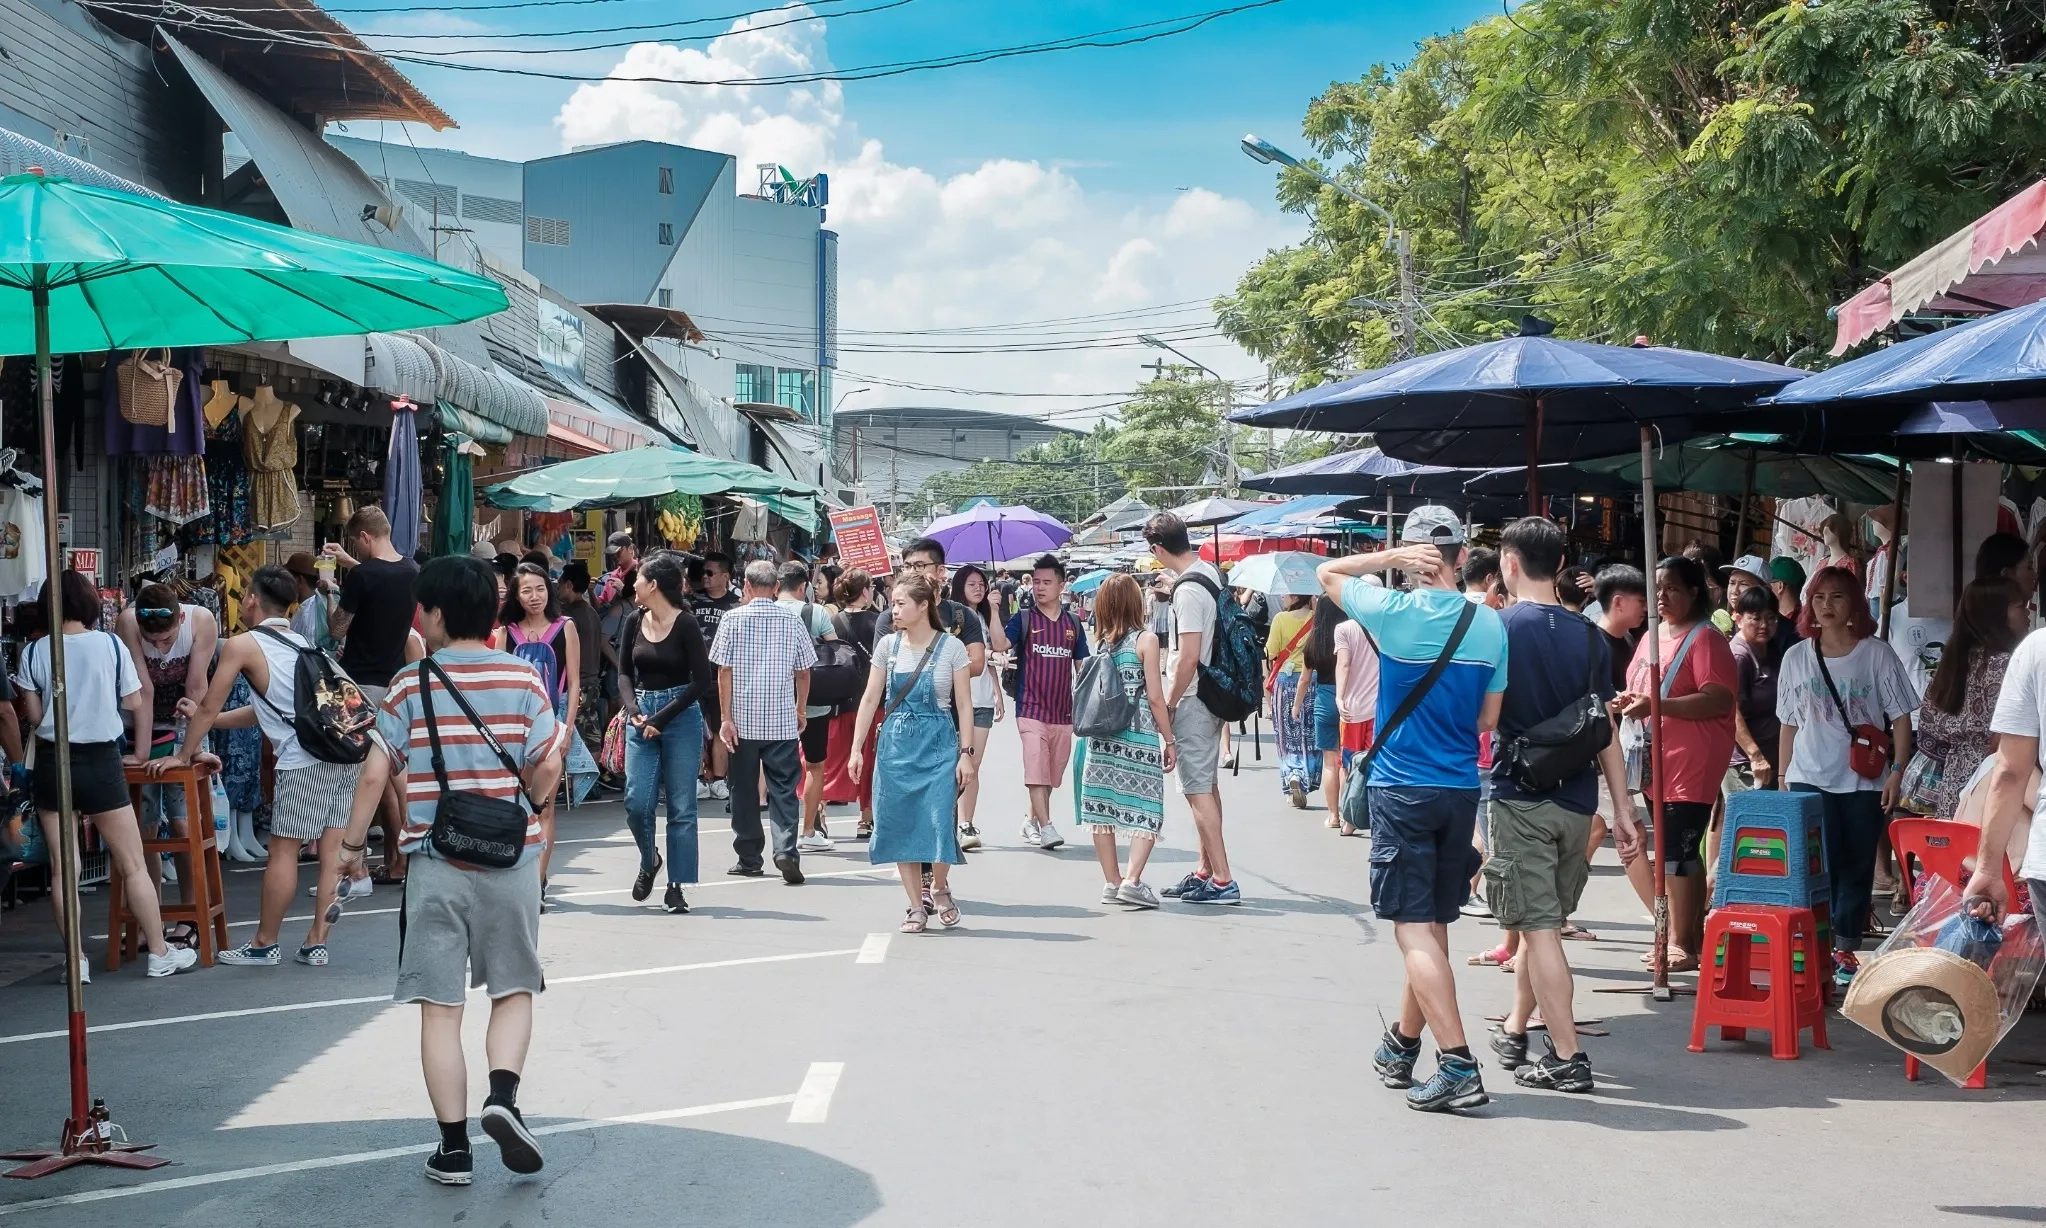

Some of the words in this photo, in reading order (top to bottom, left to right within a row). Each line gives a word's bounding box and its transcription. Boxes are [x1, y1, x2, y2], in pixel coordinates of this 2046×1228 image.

[842, 513, 873, 522] Massage
[76, 552, 95, 569] SALE
[157, 557, 171, 569] 100
[704, 615, 720, 624] CITY
[480, 726, 502, 754] OLYMPUS
[438, 825, 516, 856] Supreme
